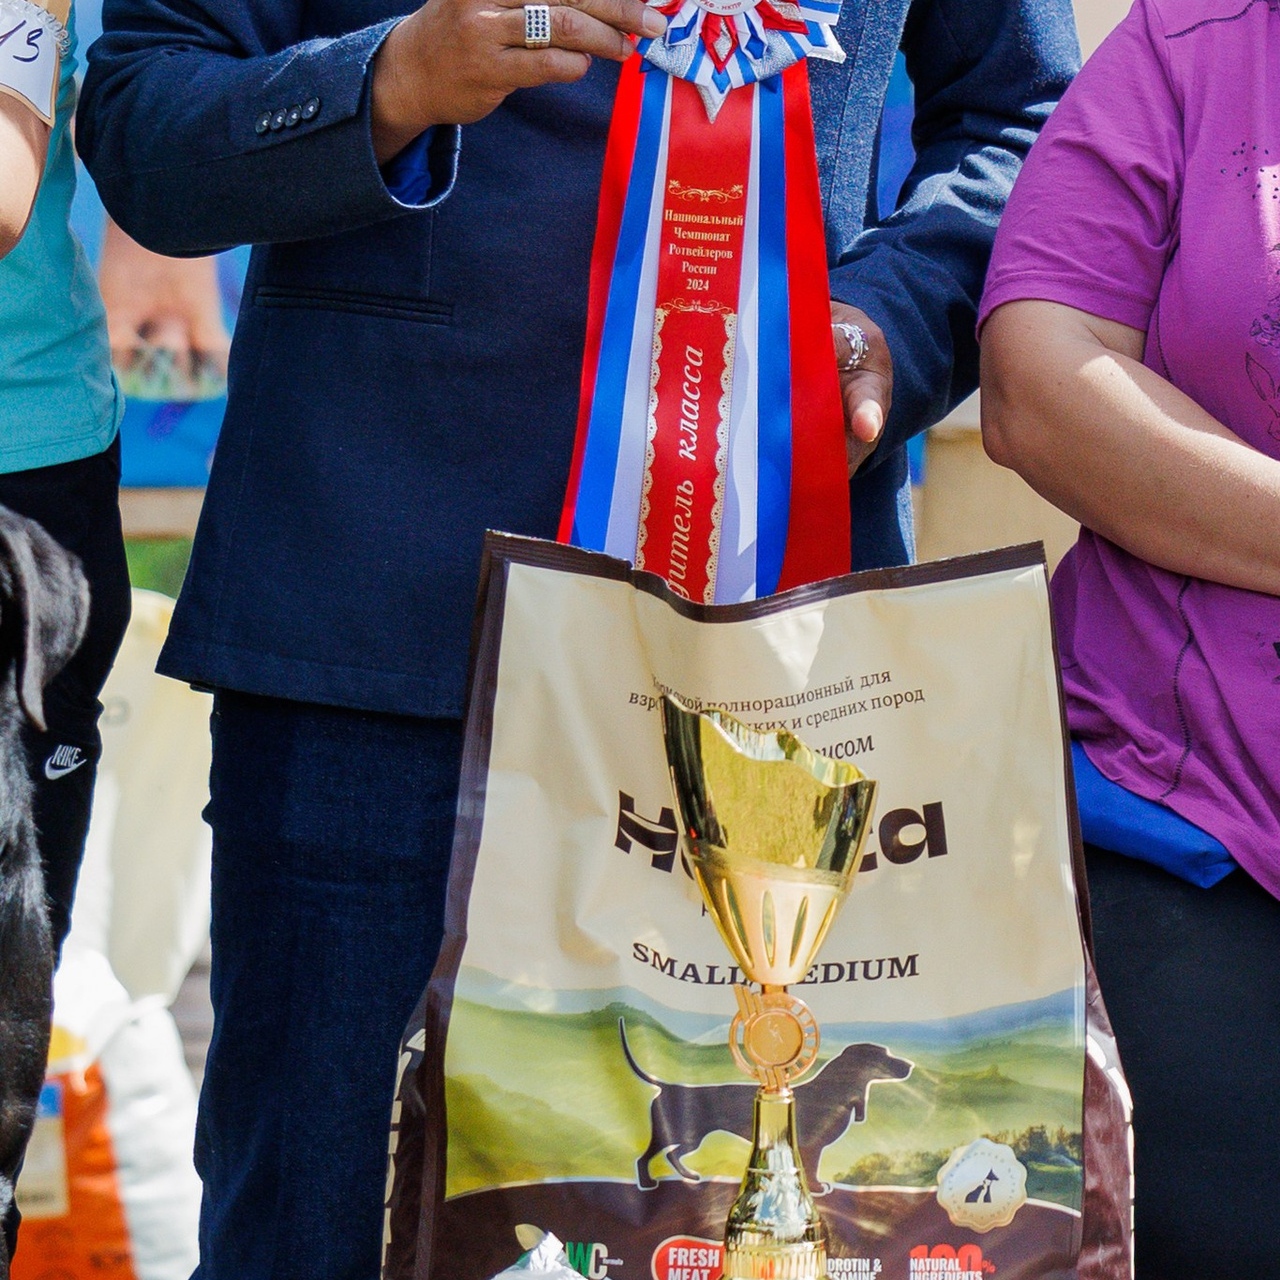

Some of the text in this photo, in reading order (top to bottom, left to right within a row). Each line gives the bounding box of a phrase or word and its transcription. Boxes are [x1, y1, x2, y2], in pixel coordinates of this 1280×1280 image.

[664, 209, 744, 227] Национальный
[673, 227, 730, 242] Чемпионат
[668, 243, 734, 260] Ротвейлеров
[681, 261, 718, 275] России
[686, 278, 710, 291] 2024
[678, 344, 704, 462] класса
[860, 669, 892, 691] для
[792, 717, 803, 730] и
[806, 698, 868, 729] средних
[871, 688, 926, 710] пород
[52, 743, 82, 767] NIKE
[668, 1247, 720, 1268] FRESH
[910, 1258, 961, 1272] NATURAL
